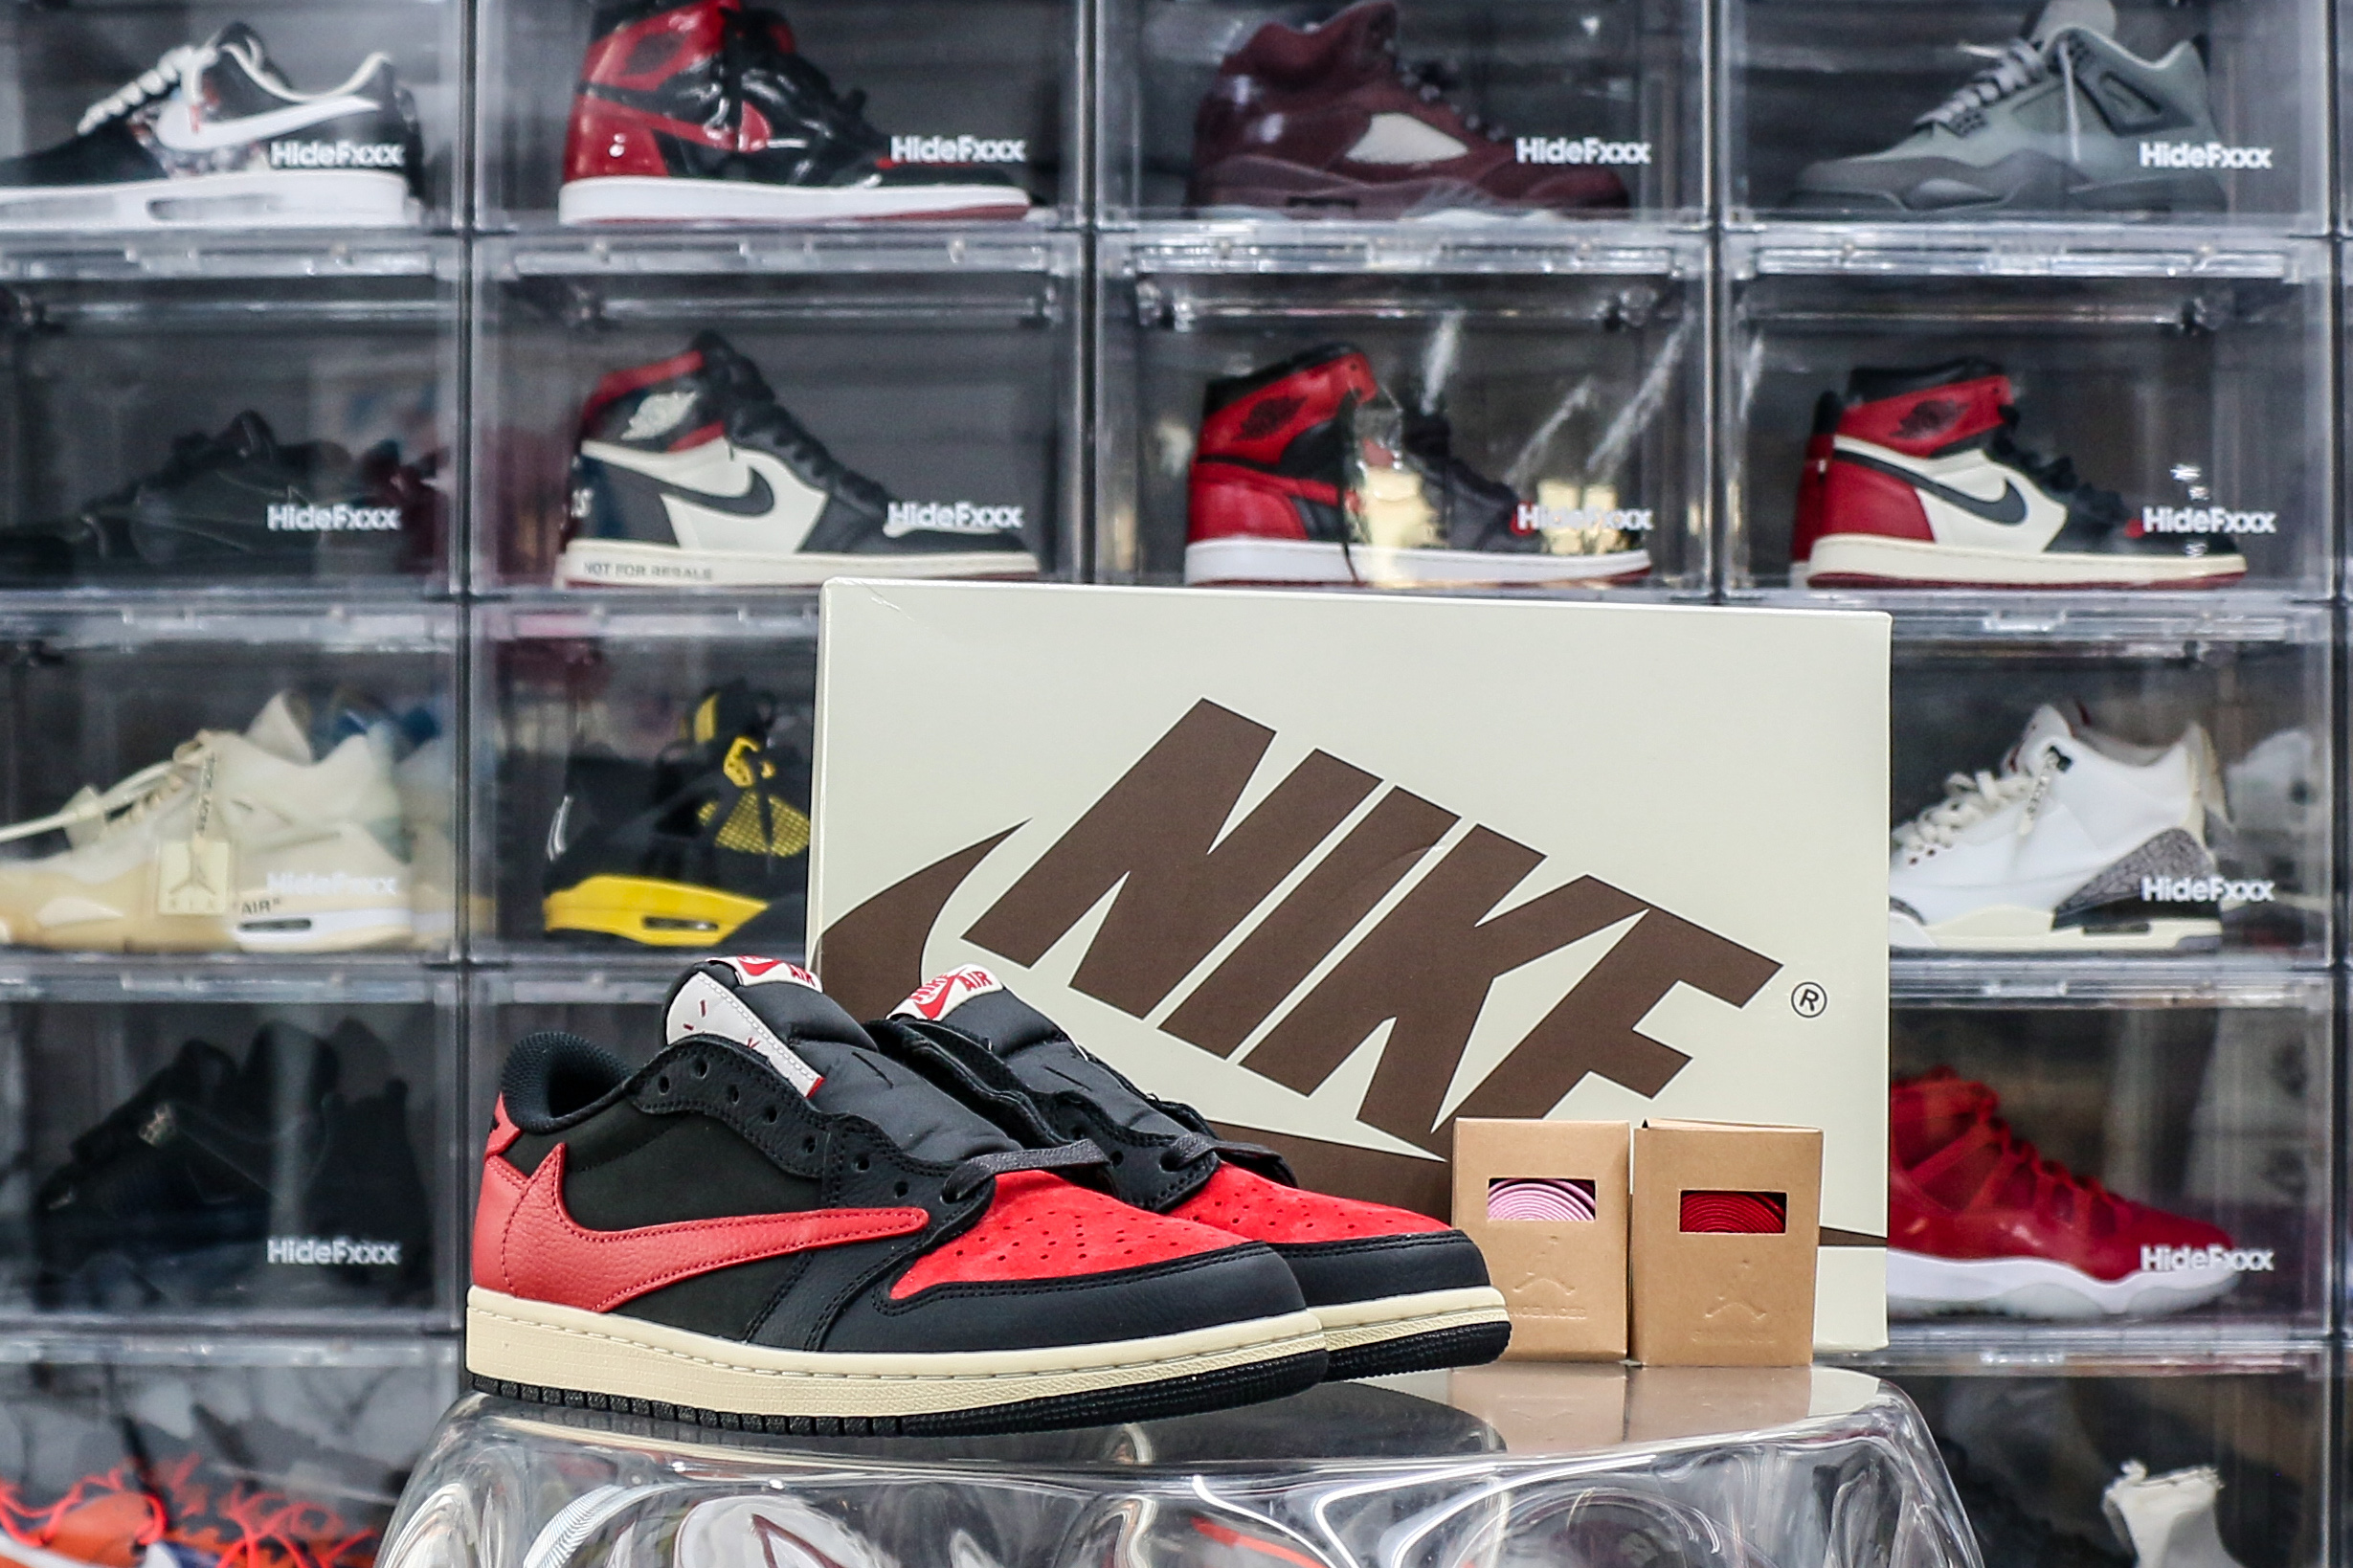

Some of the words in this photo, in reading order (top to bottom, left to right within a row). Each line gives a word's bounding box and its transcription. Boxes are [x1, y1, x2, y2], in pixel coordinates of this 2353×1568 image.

[271, 141, 405, 167] HideFxxx
[889, 135, 1026, 163] HideFxxx
[1515, 136, 1652, 165] HideFxxx
[2139, 141, 2273, 168] HideFxxx
[267, 504, 401, 530] HideFxxx
[887, 501, 1023, 528] HideFxxx
[2142, 505, 2276, 533] HideFxxx
[616, 563, 645, 576] FOR
[2140, 875, 2275, 902] HideFxxx
[958, 970, 994, 992] AIR
[267, 1236, 401, 1265] HideFxxx
[2140, 1243, 2275, 1271] HideFxxx
